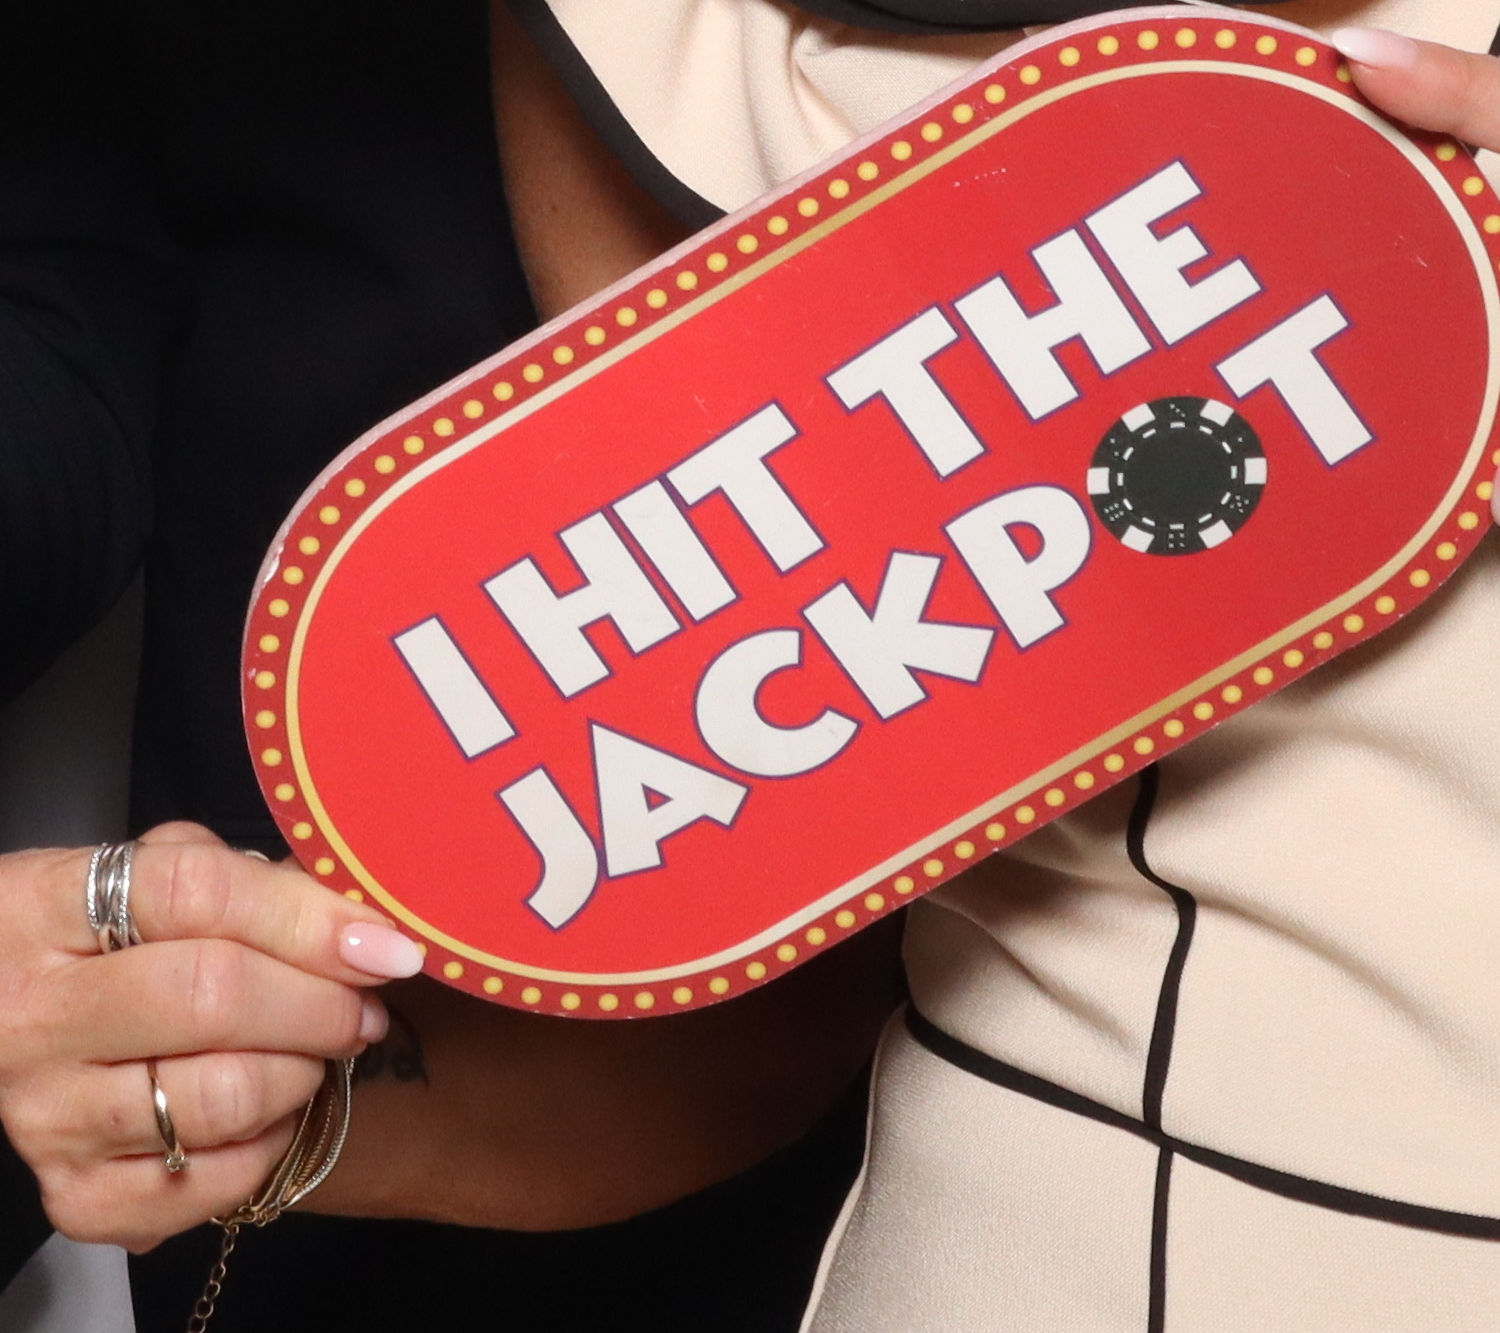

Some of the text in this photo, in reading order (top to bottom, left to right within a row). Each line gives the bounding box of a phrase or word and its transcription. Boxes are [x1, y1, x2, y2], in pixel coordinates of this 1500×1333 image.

[392, 158, 1263, 761] I HIT THE
